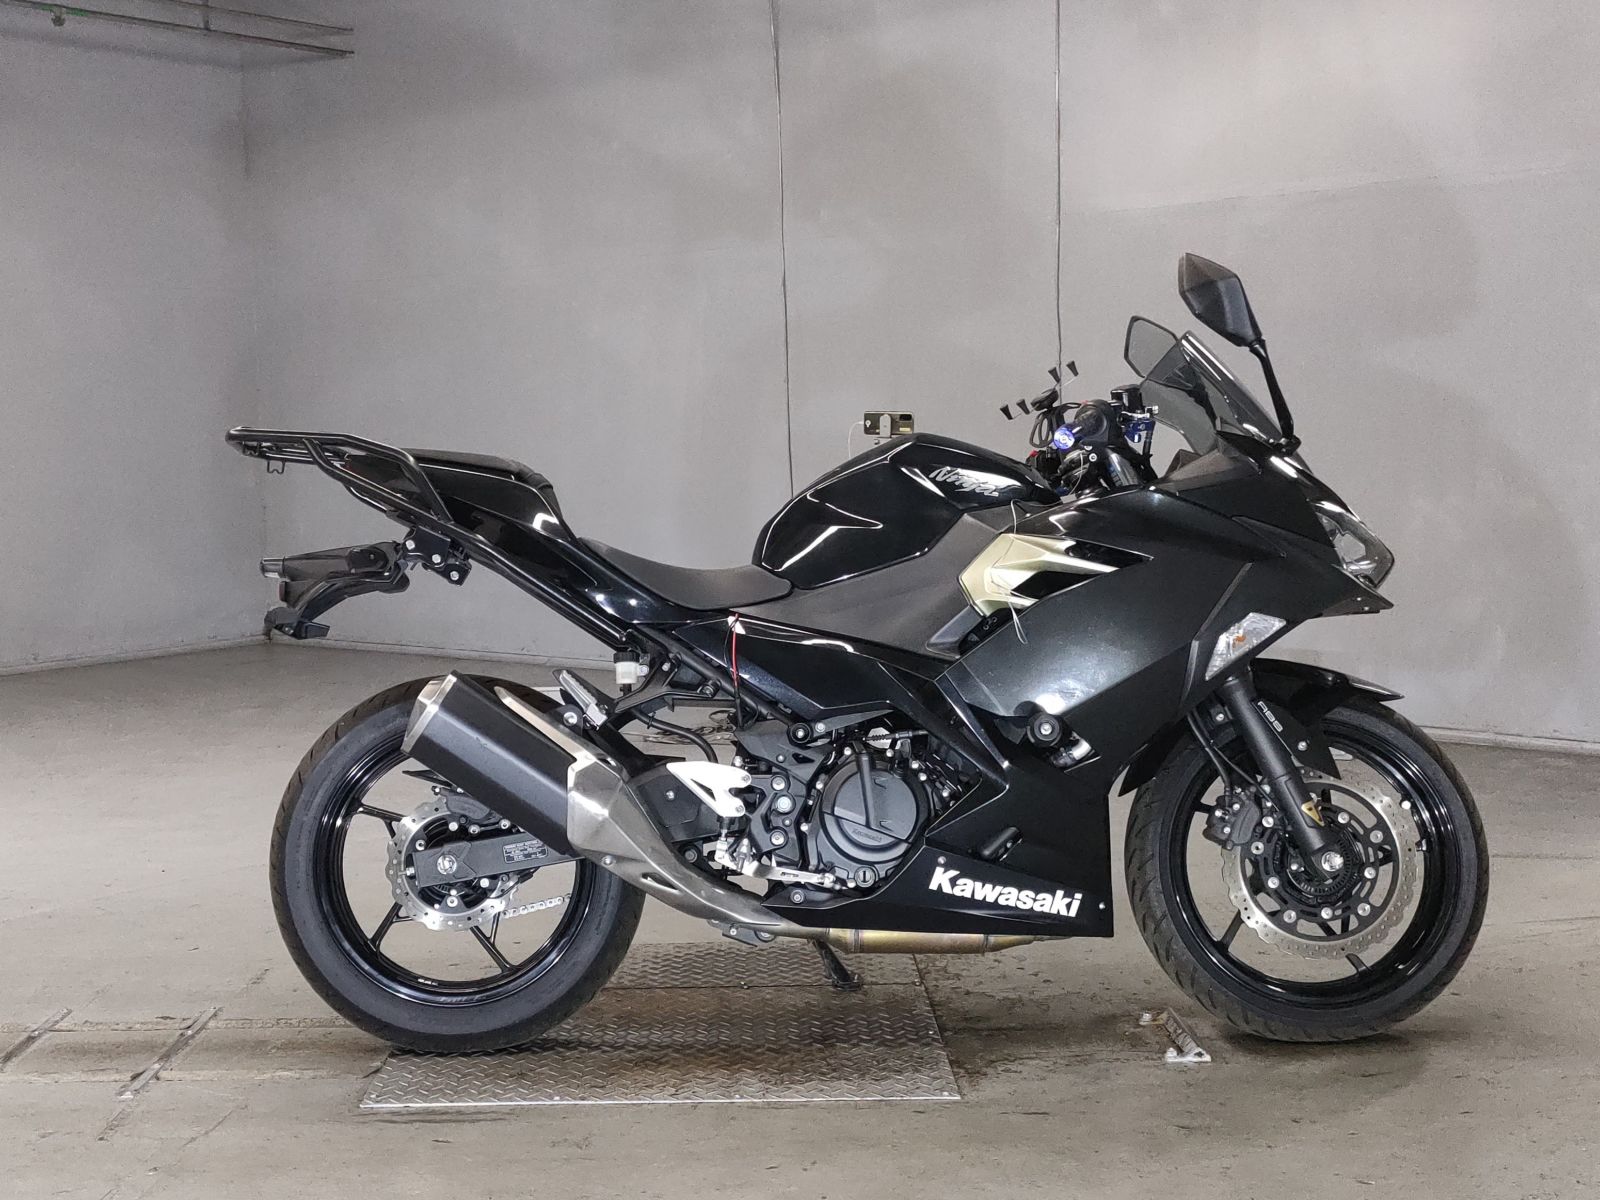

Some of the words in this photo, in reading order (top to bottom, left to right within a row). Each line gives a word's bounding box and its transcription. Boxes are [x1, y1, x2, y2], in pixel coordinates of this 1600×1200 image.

[928, 466, 999, 497] Ninja
[1257, 701, 1284, 732] ABS
[928, 866, 1083, 917] Kawasaki
